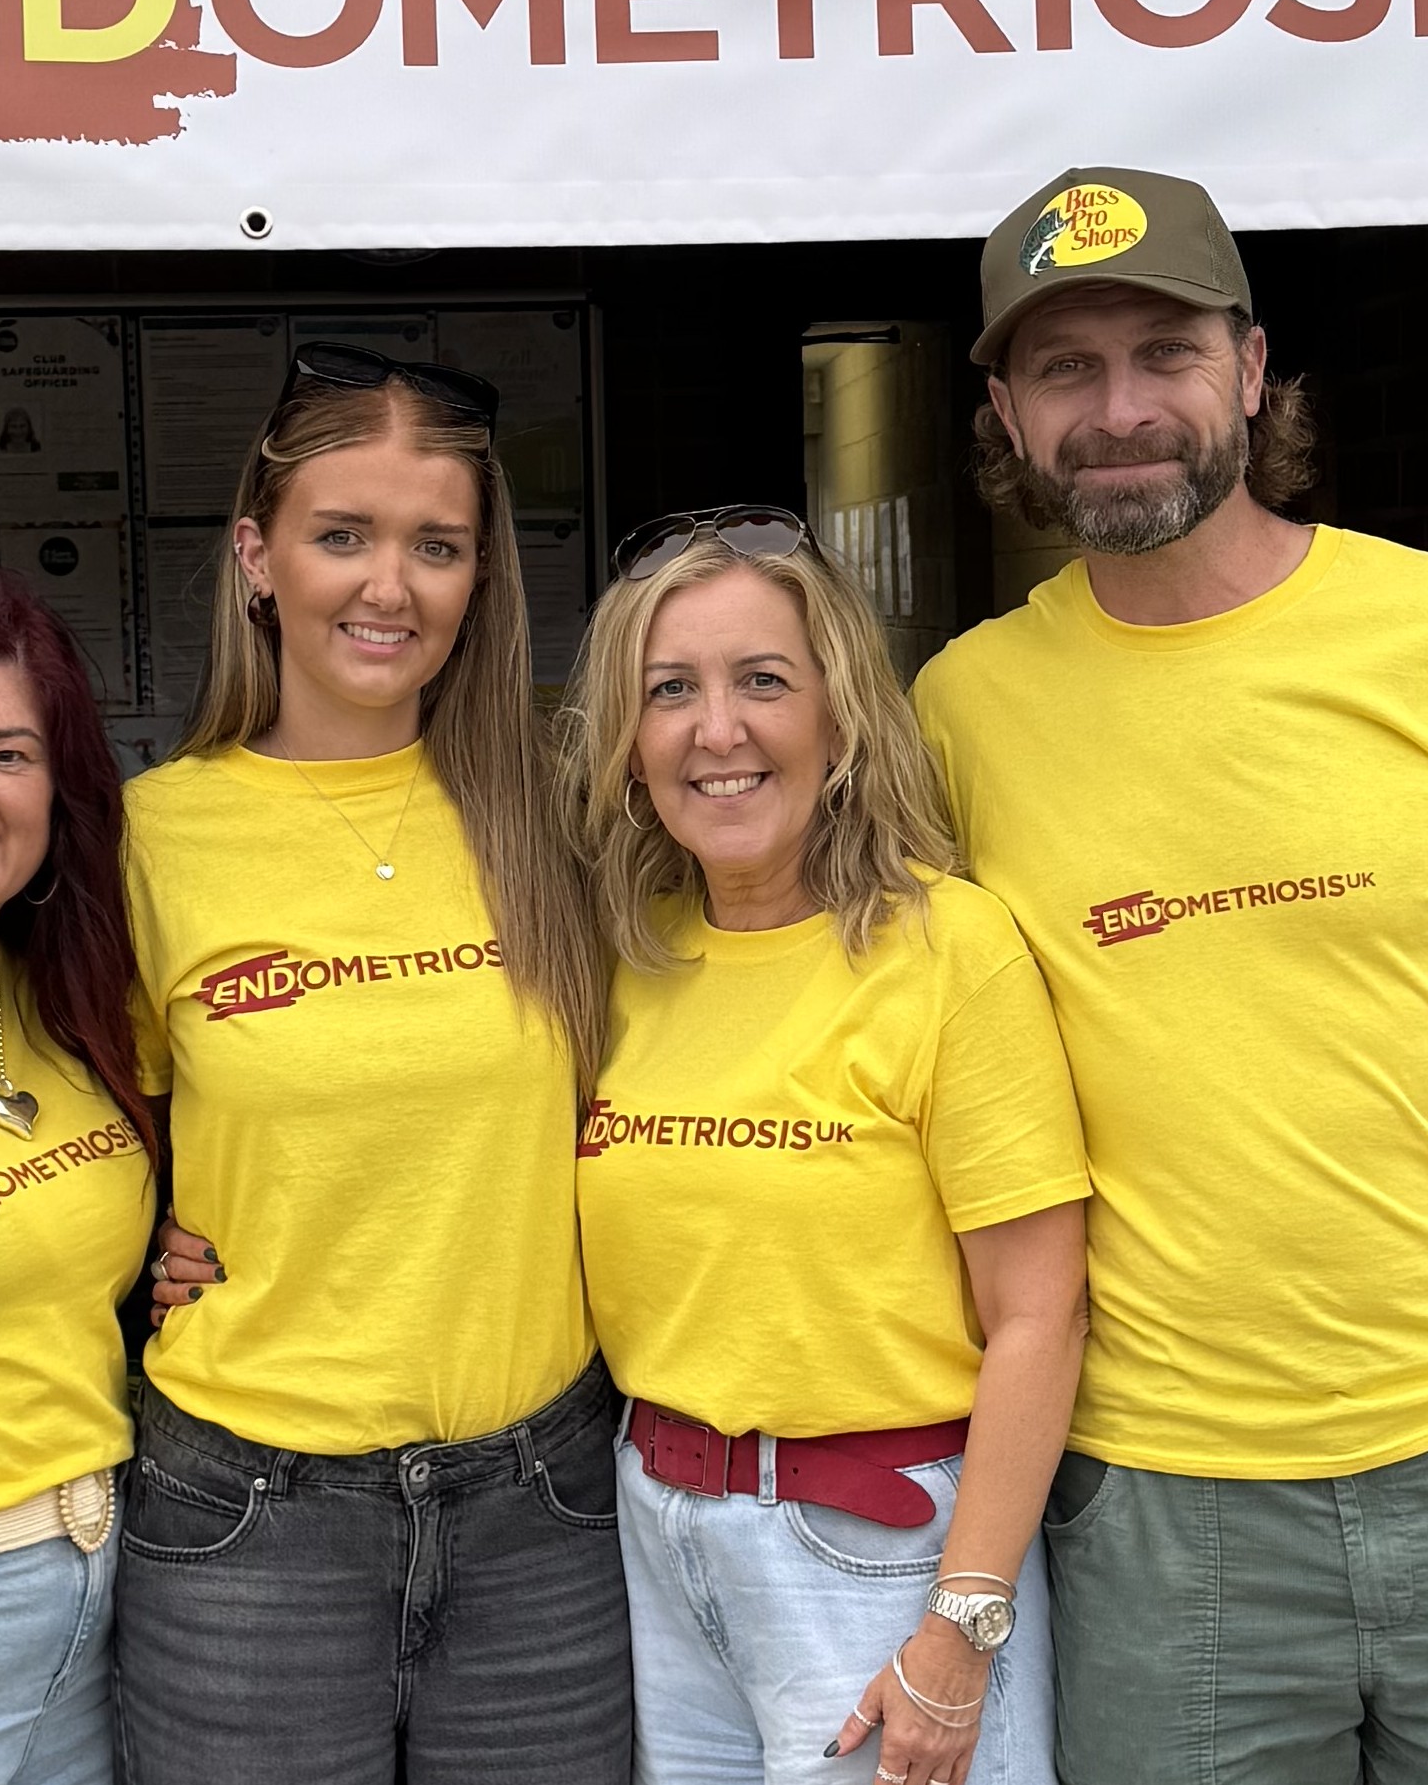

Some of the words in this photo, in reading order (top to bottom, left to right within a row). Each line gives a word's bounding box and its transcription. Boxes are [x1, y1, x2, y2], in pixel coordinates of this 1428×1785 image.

[1065, 188, 1121, 214] Bass
[1070, 209, 1108, 232] Pro
[1071, 227, 1139, 251] Shops
